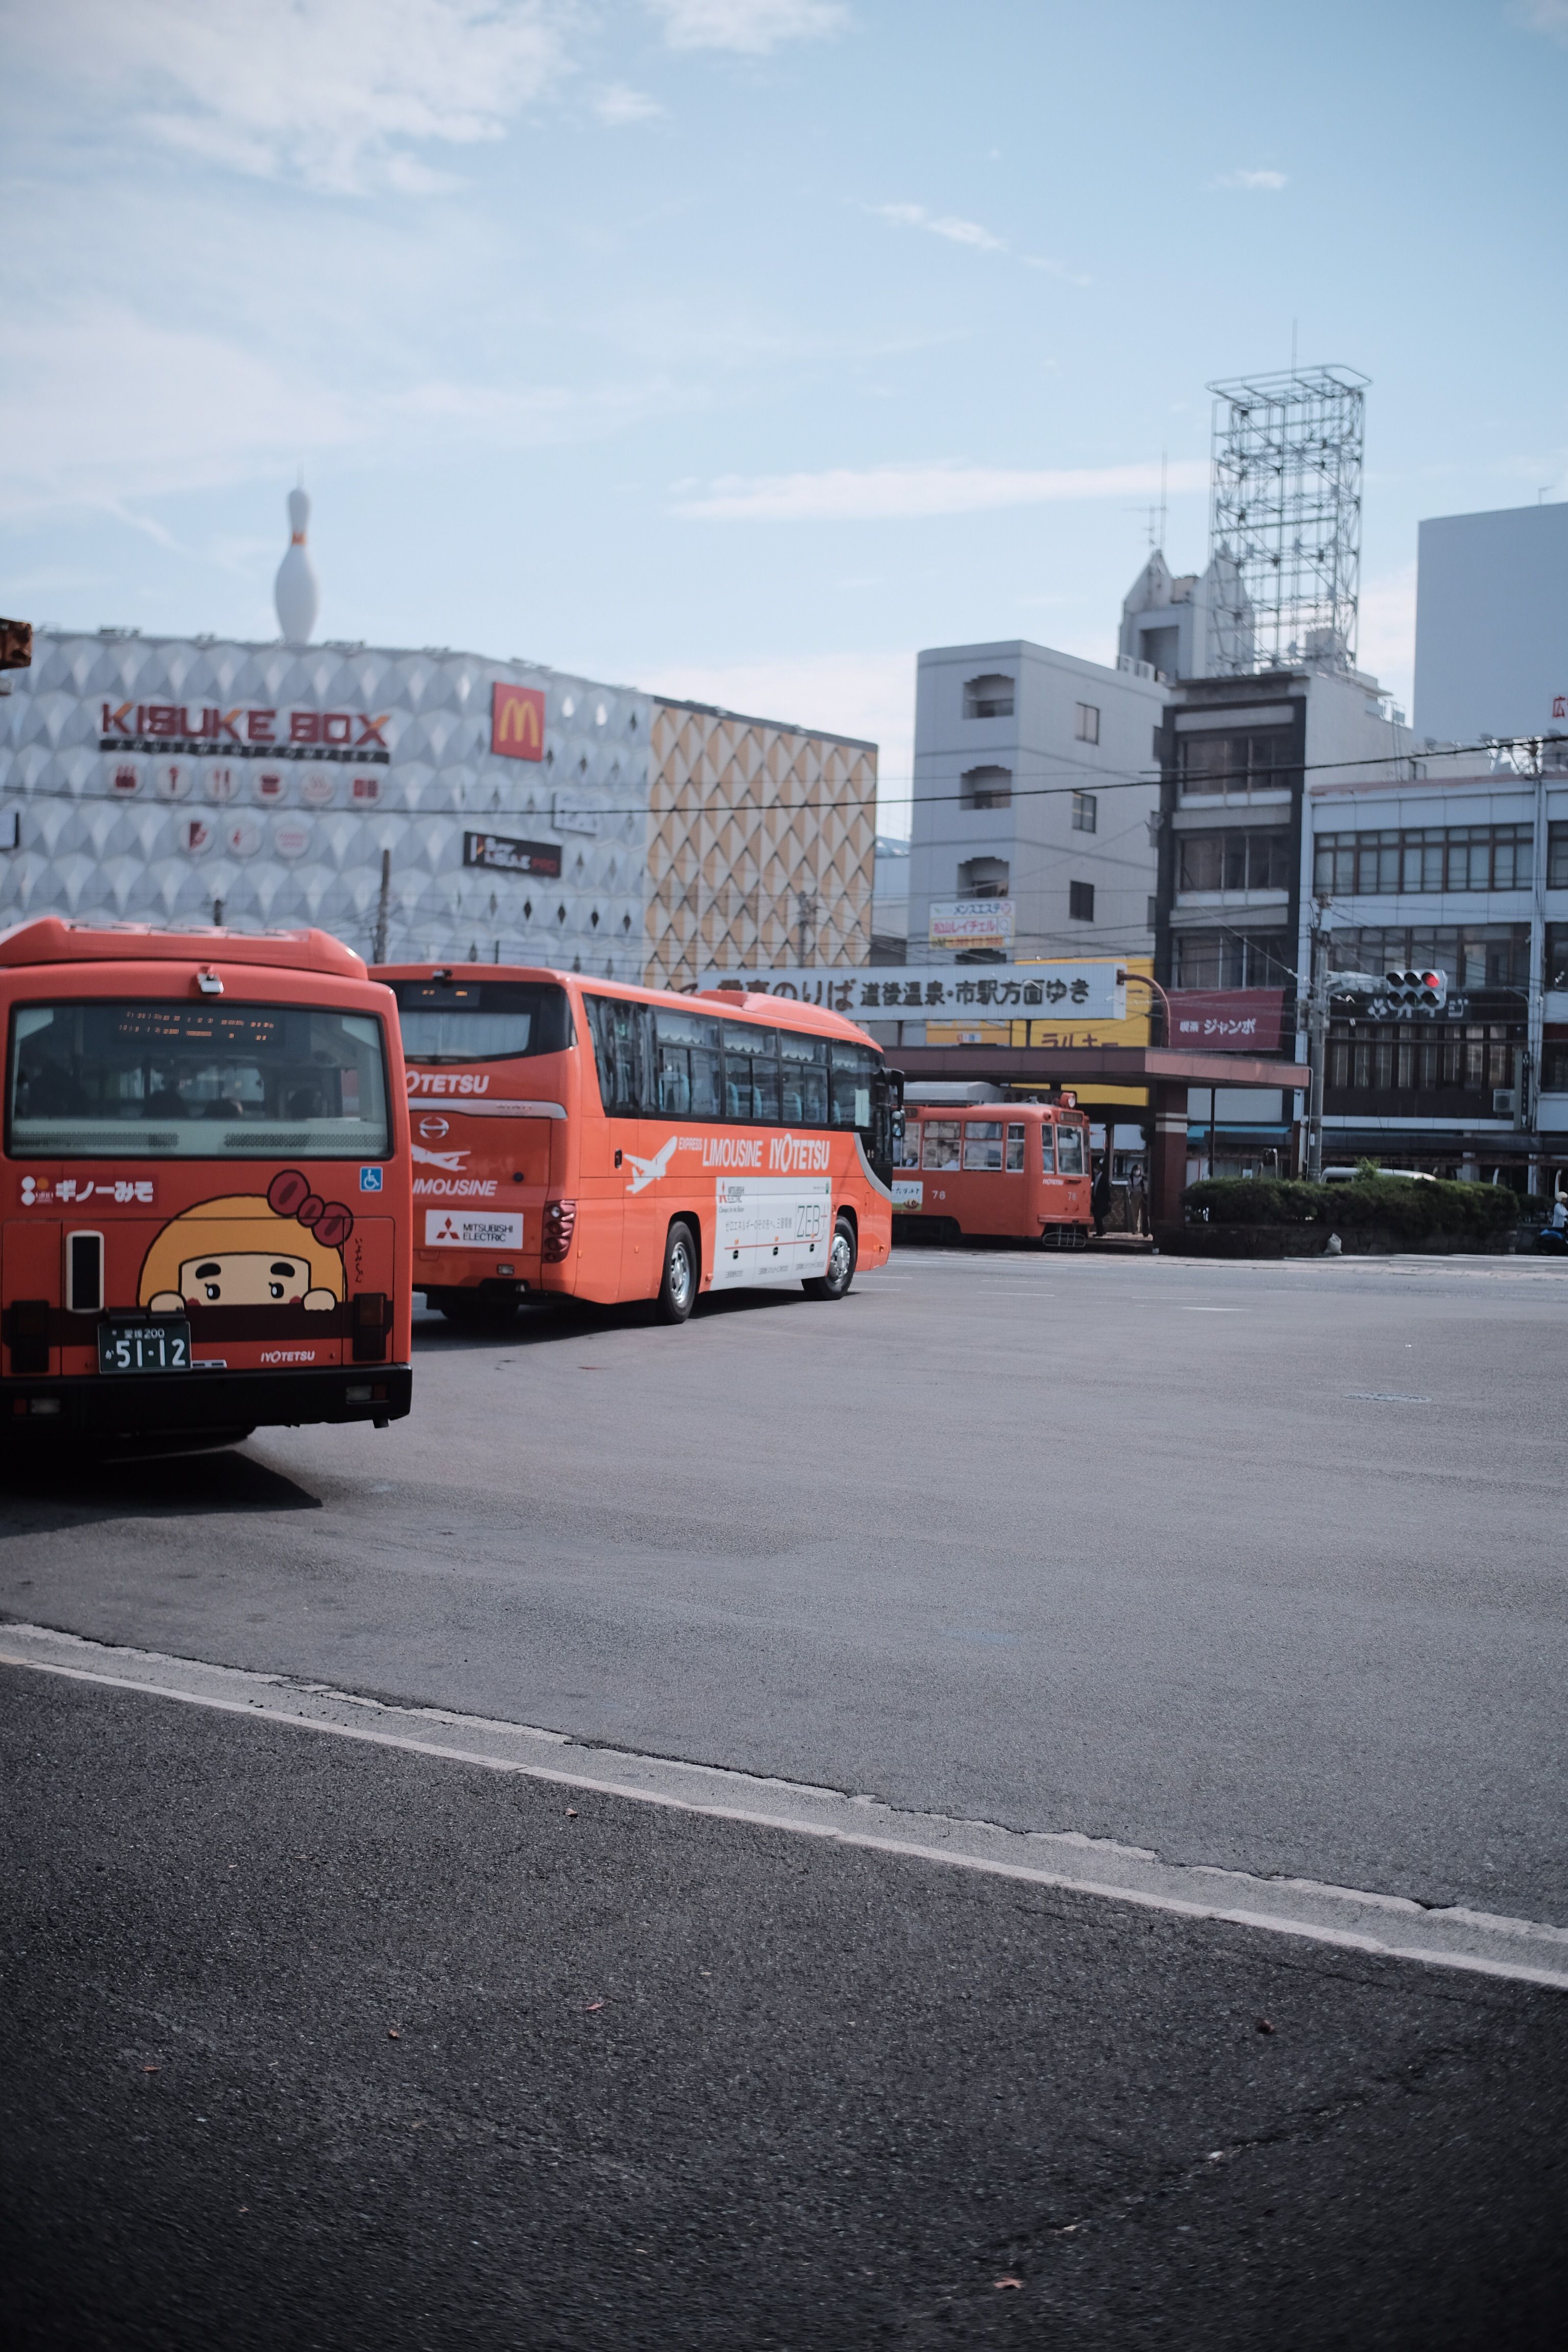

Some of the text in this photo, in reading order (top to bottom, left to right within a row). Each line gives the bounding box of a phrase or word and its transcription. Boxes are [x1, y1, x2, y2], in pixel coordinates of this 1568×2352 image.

[1552, 695, 1568, 718] 広
[102, 702, 390, 747] KISUKE BOX
[861, 978, 1089, 1006] 道後温泉・市駅方面ゆき
[1204, 1018, 1256, 1035] ジャンボ
[678, 1133, 830, 1172] EXPRESS LIMOUSINE IYOTETSU
[56, 1180, 153, 1203] ギノーみそ
[932, 1190, 946, 1200] 78
[1068, 1192, 1076, 1200] 78
[463, 1223, 513, 1233] MITSUBISHI
[463, 1232, 506, 1242] ELECTRIC
[116, 1338, 186, 1367] 51-12
[261, 1350, 315, 1363] IYOTETSU
